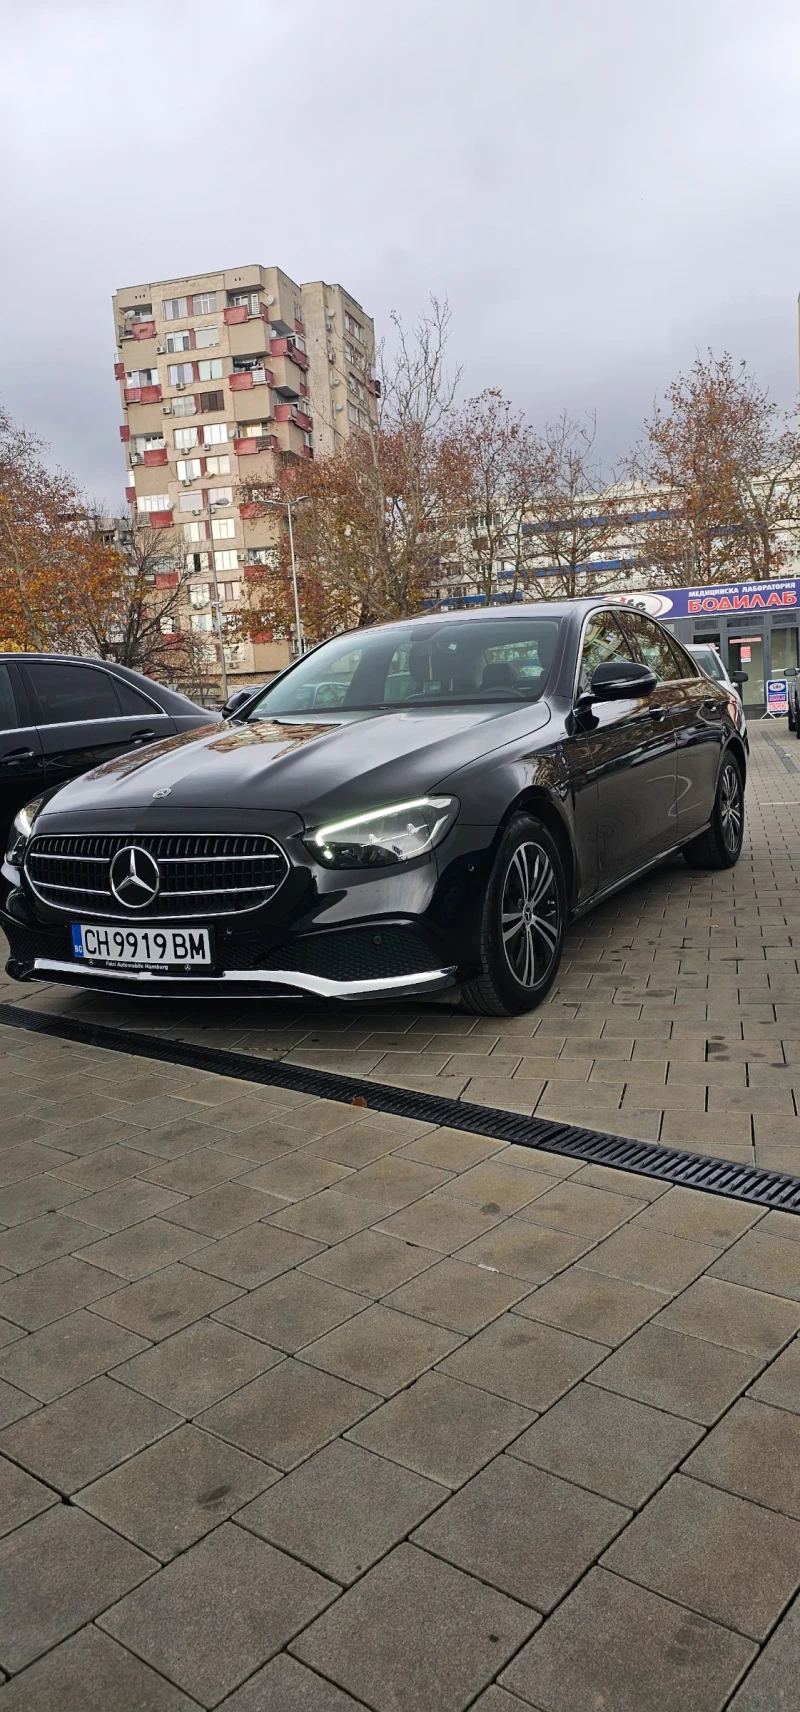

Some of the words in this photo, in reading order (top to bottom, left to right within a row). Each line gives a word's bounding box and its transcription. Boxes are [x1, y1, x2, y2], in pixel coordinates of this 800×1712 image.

[688, 587, 739, 597] МЕДИЦИНСКА
[742, 582, 796, 593] ЛАБОРАТОРИЯ
[688, 591, 797, 613] БОДИЛАБ
[74, 944, 83, 953] BG
[144, 963, 169, 971] Hamburg
